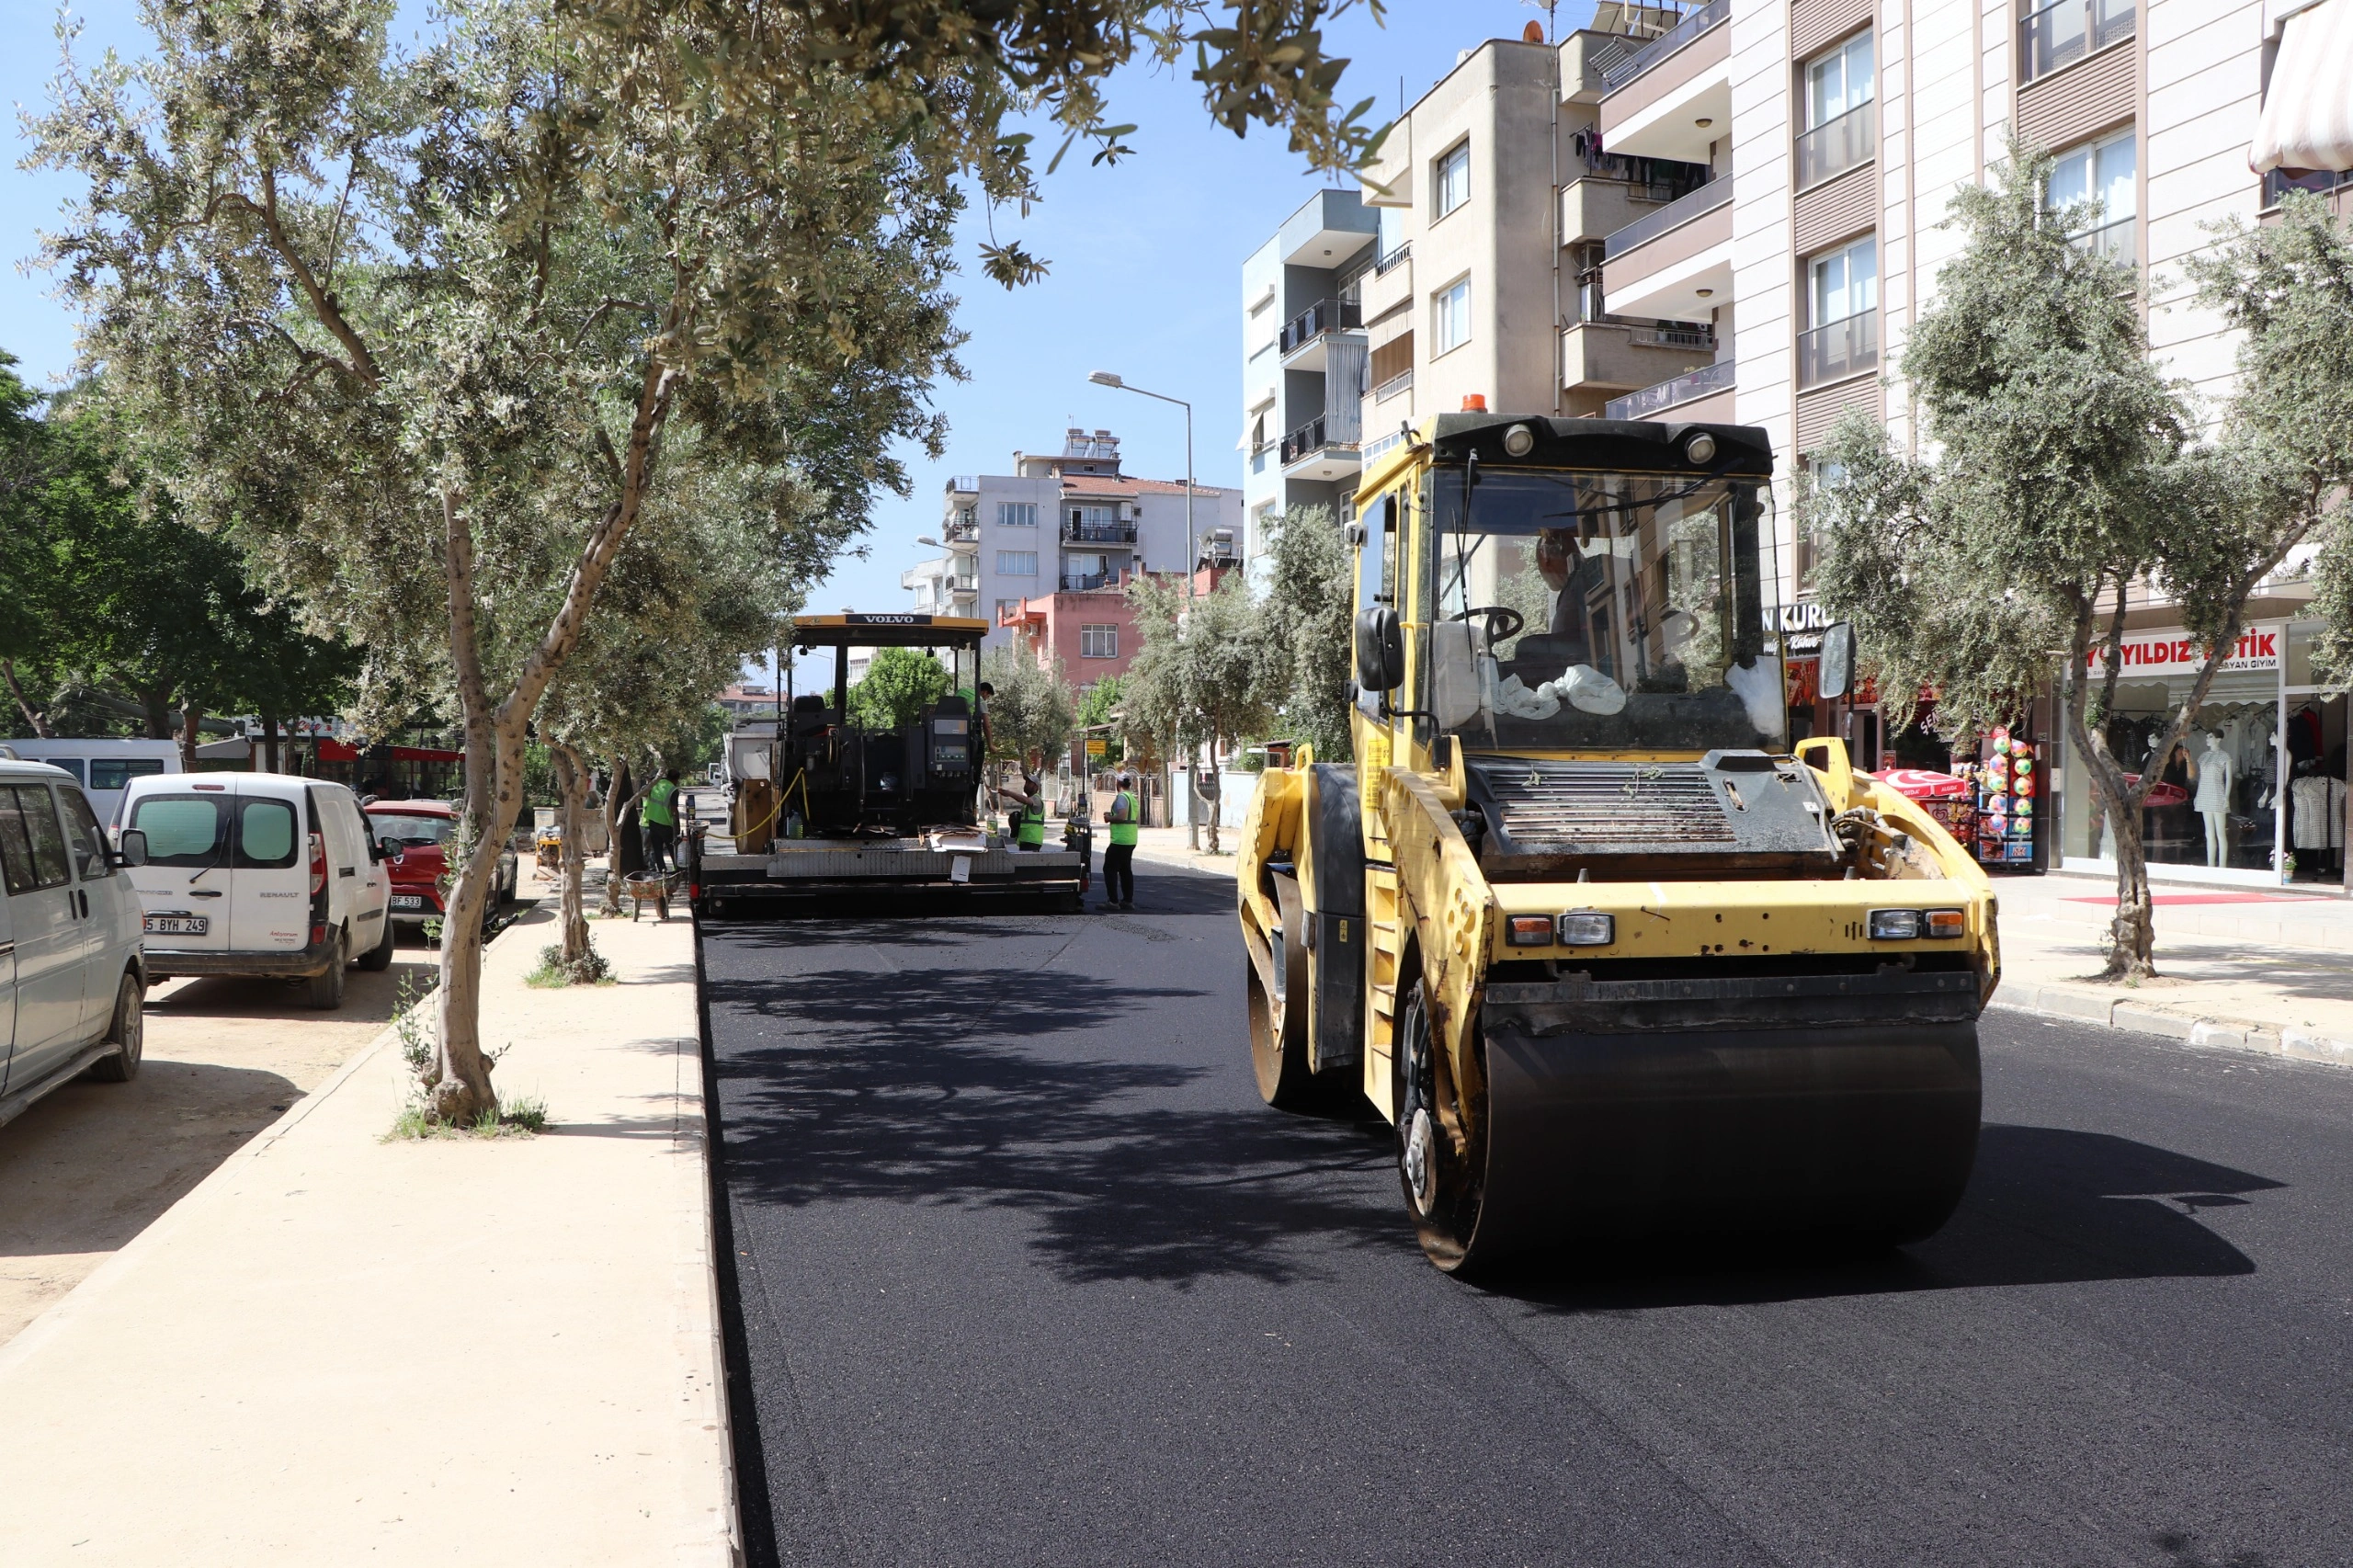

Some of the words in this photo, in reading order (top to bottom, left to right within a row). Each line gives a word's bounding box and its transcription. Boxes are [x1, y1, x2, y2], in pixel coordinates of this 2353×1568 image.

[864, 615, 915, 624] VOLVO
[1790, 634, 1819, 650] Kahve
[2120, 640, 2192, 665] YILDIZ
[2250, 657, 2277, 669] GİYİM
[392, 896, 403, 905] BF
[404, 897, 420, 905] 533
[159, 919, 179, 931] BYH
[186, 920, 205, 932] 249
